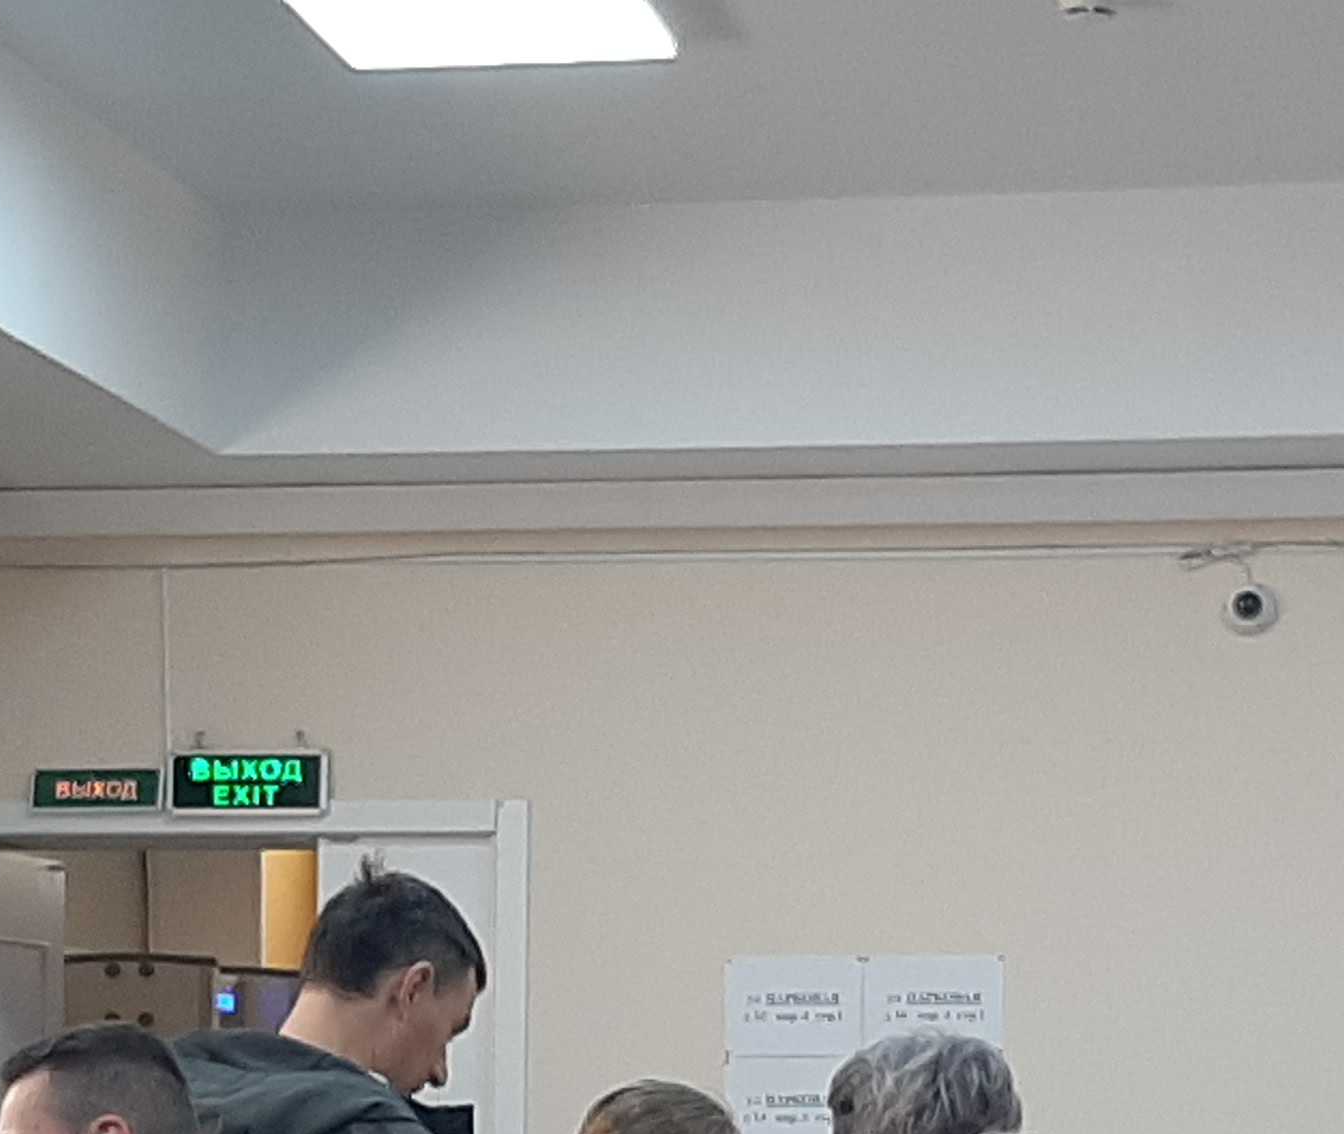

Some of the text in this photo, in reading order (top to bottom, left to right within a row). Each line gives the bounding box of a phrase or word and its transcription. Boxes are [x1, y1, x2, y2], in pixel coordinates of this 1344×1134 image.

[190, 756, 303, 783] ВЫХОД
[54, 779, 138, 801] ВЫХОД
[212, 784, 280, 807] EXIT
